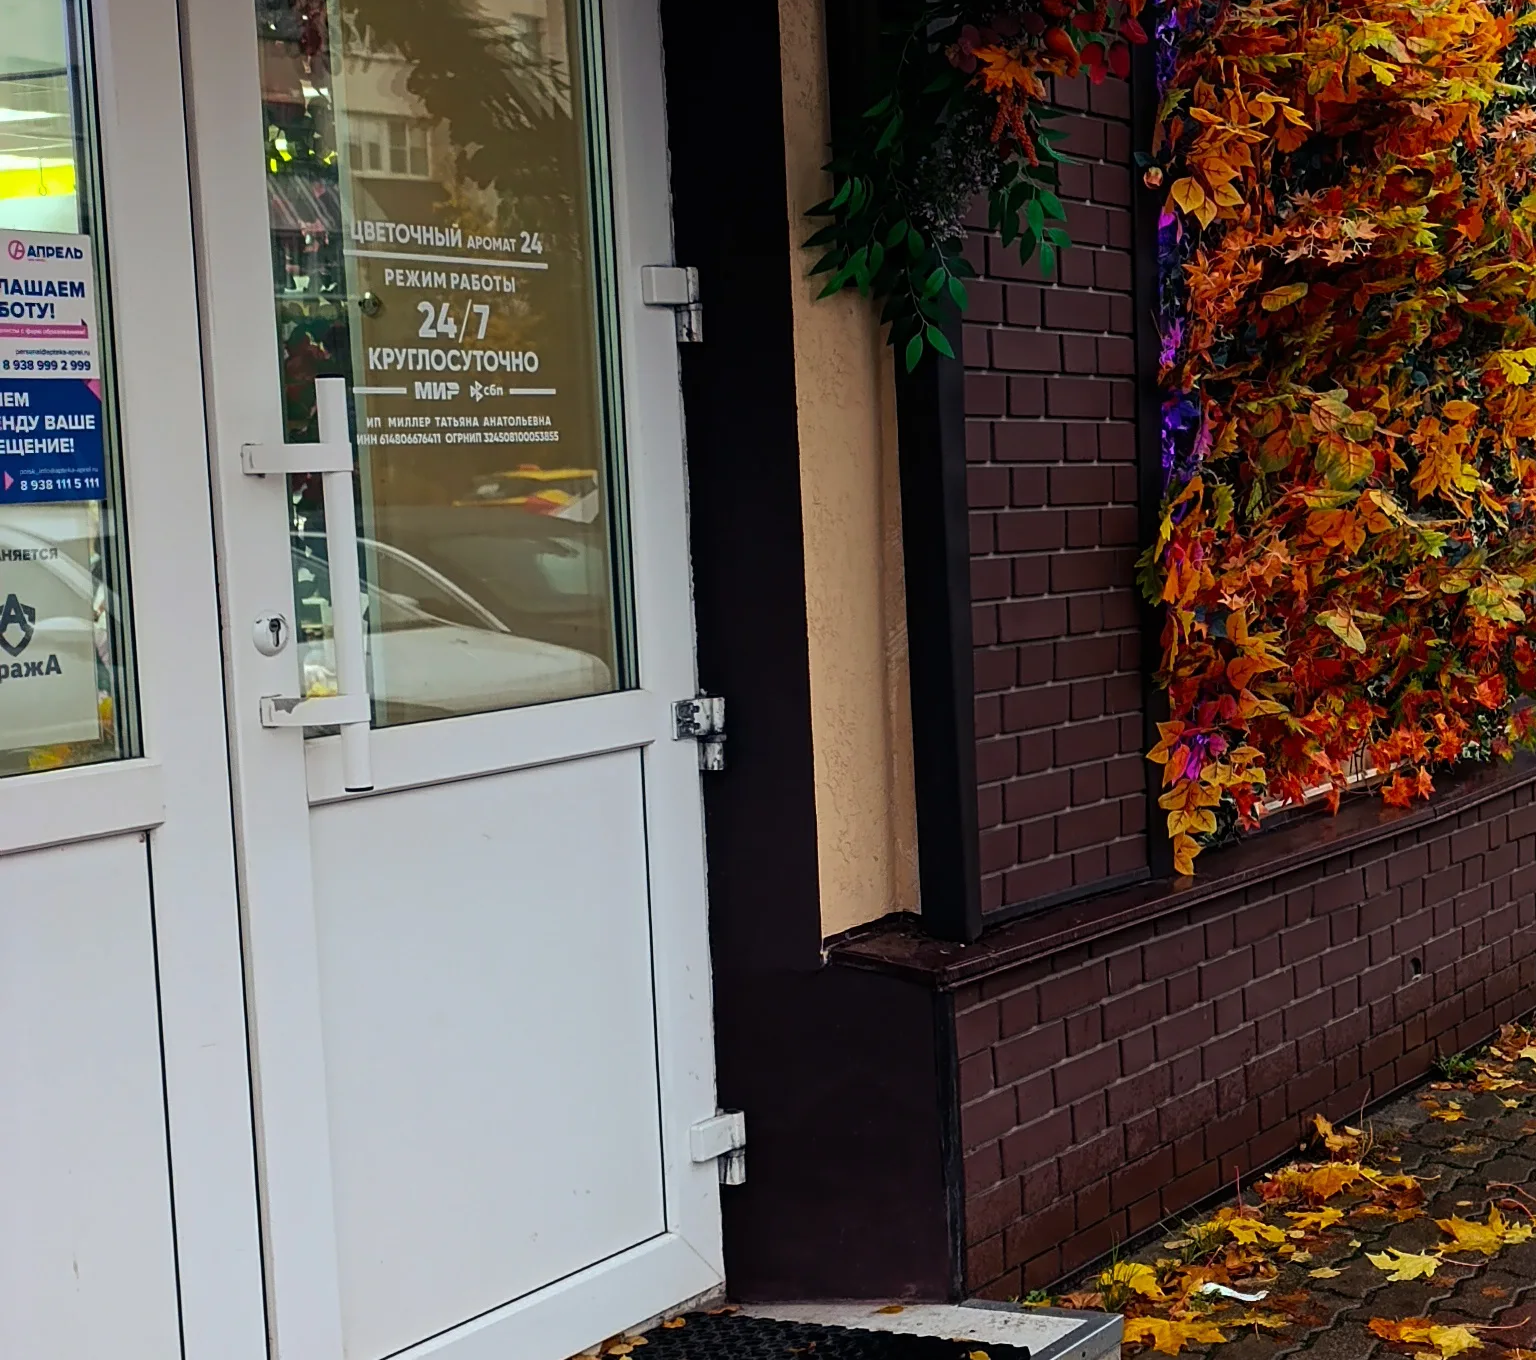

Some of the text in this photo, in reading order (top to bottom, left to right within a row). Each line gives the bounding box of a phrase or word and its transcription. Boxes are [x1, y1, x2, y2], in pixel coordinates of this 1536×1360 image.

[351, 220, 543, 254] ЦВЕТОЧНЫЙ АРОМАТ 24
[27, 245, 83, 259] АПРЕЛЬ
[384, 268, 516, 293] РЕЖИМ РАБОТЫ
[417, 299, 490, 343] 24/7
[3, 360, 91, 371] 8 938 999 2 999
[369, 347, 539, 373] КРУГЛОСУТОЧНО
[414, 381, 460, 400] МИР
[0, 392, 29, 407] ЕМ
[0, 415, 95, 433] НДУ ВАШЕ
[366, 416, 551, 428] ИП МИЛЛЕР ТАТЬЯНА АНАТОЛЬЕВНА
[357, 434, 378, 445] ИНН
[445, 432, 482, 444] ОГРНИП
[20, 478, 100, 490] 8 938 111 5 111
[0, 548, 59, 561] НЯЕТСЯ
